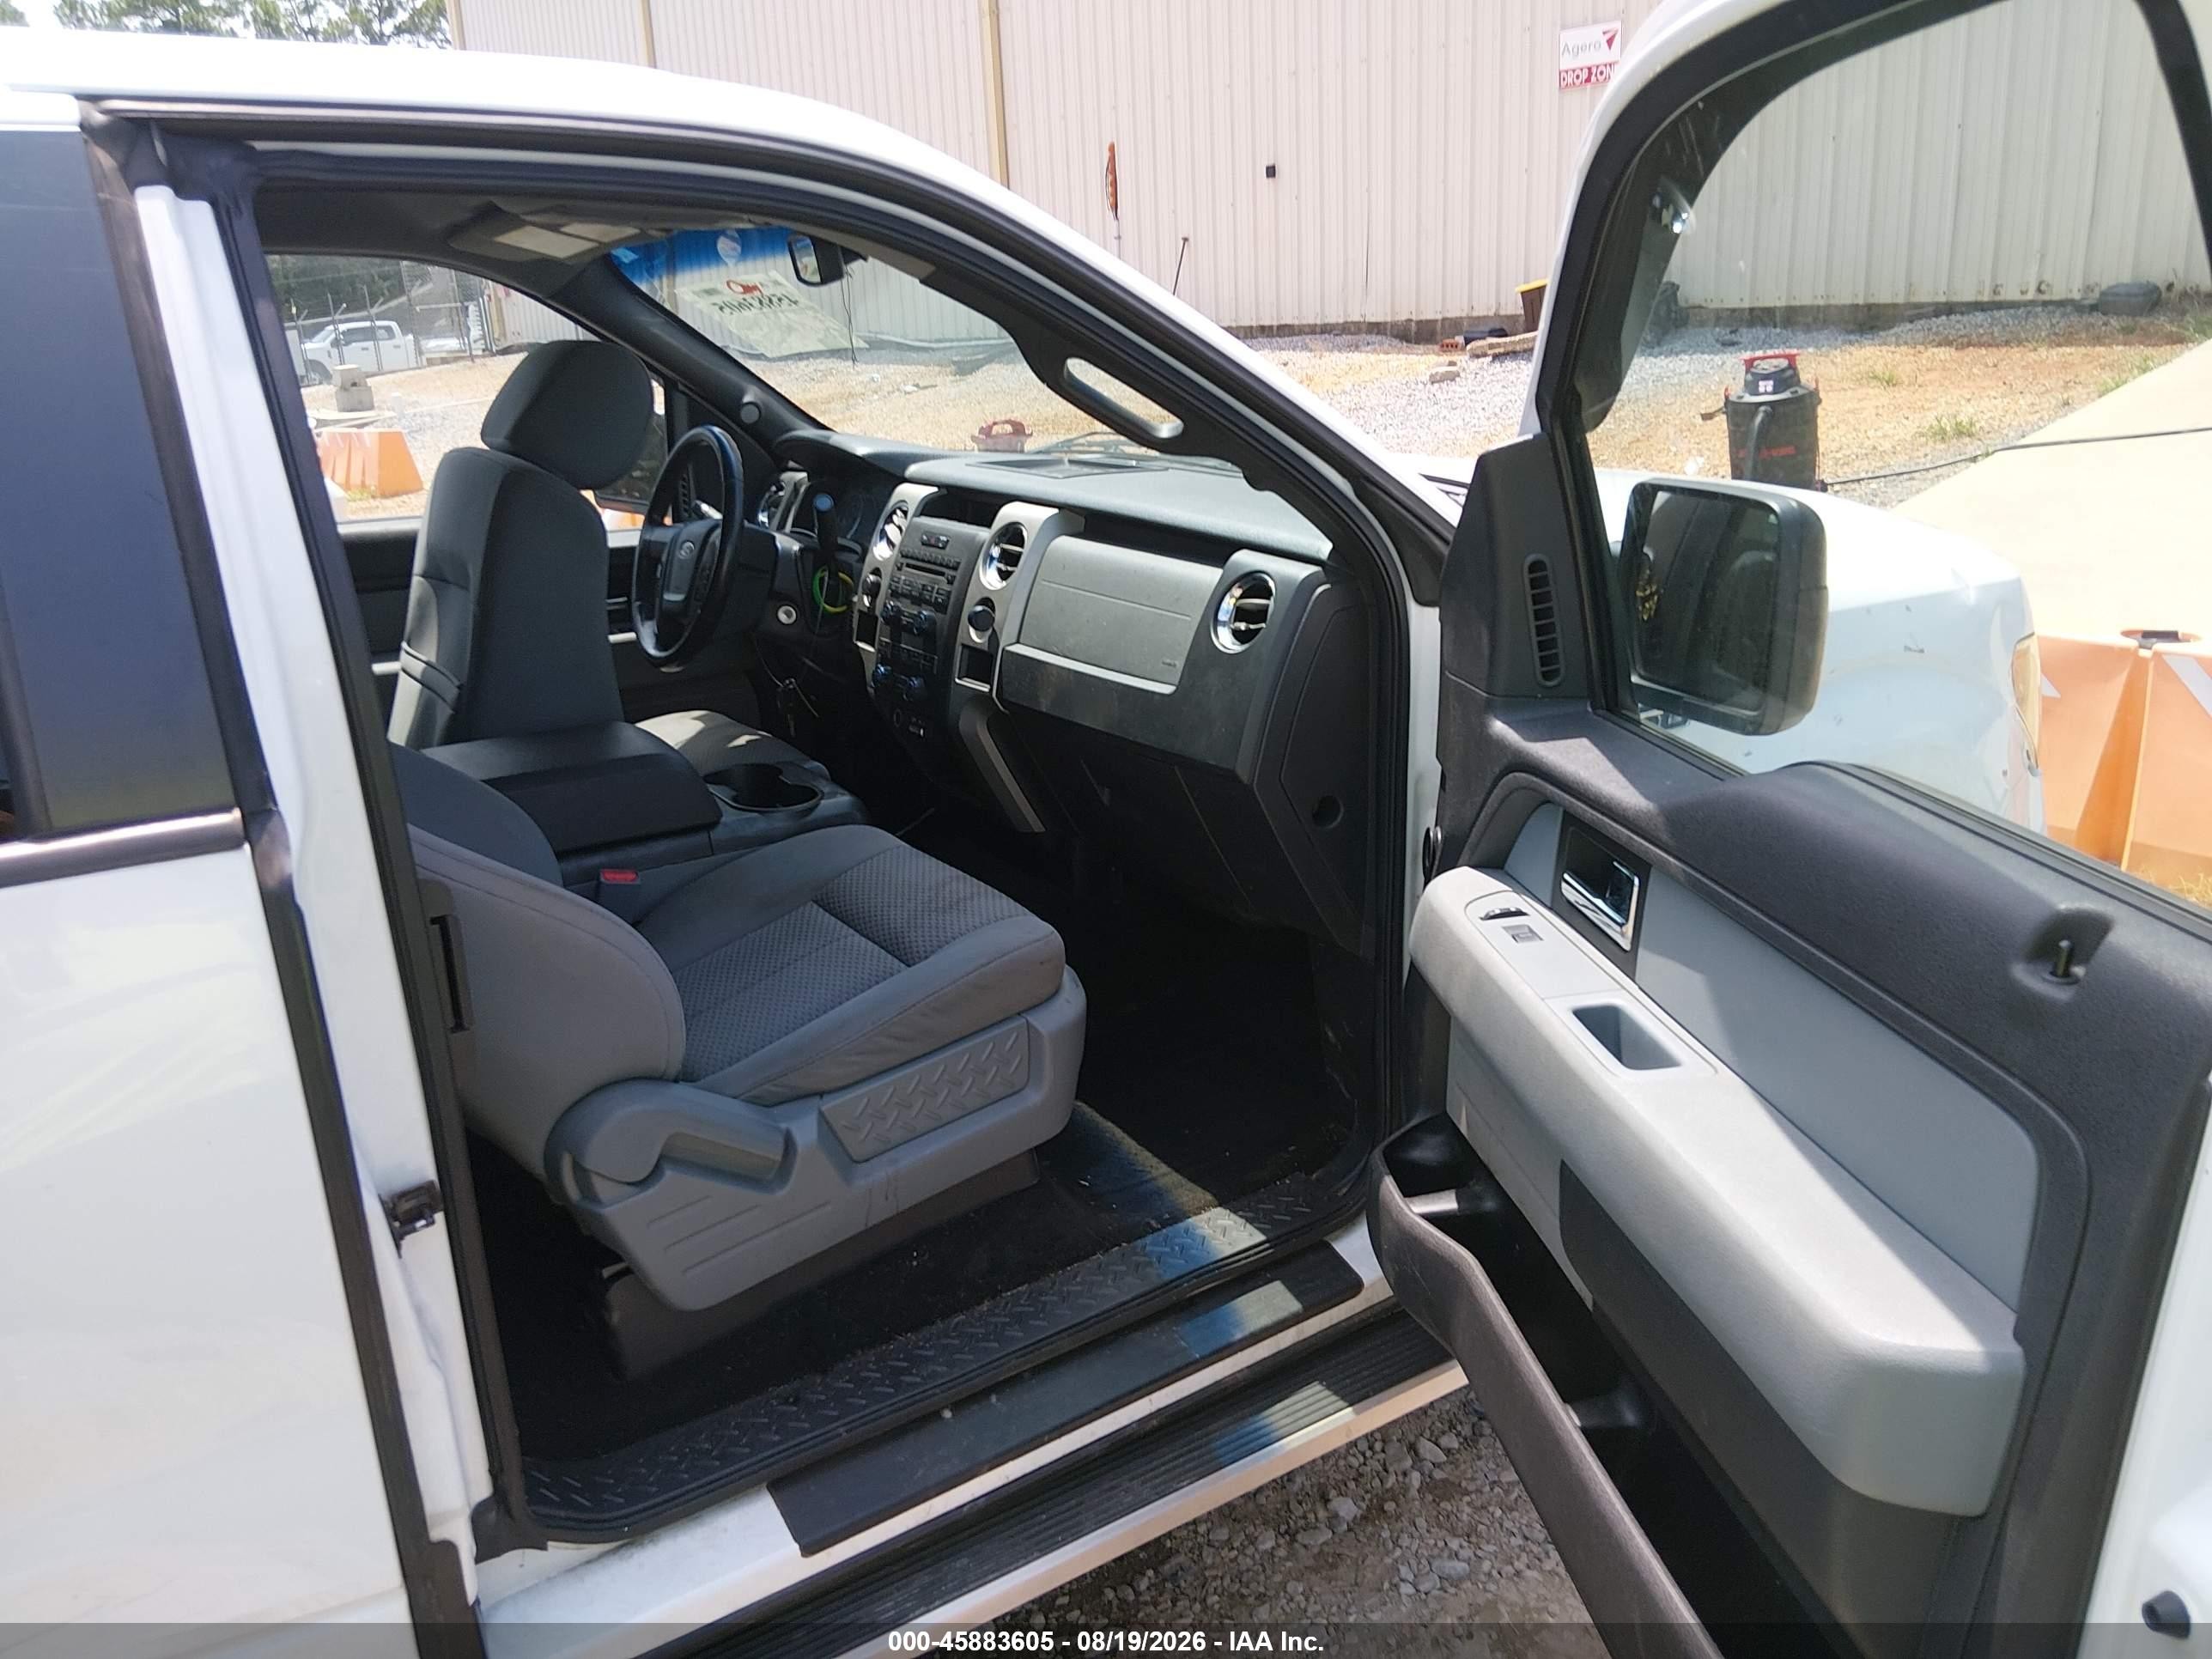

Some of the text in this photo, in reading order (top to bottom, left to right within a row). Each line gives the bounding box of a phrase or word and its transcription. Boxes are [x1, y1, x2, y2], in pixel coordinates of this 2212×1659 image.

[1561, 40, 1602, 58] Agero
[1560, 64, 1617, 88] DROP ZON
